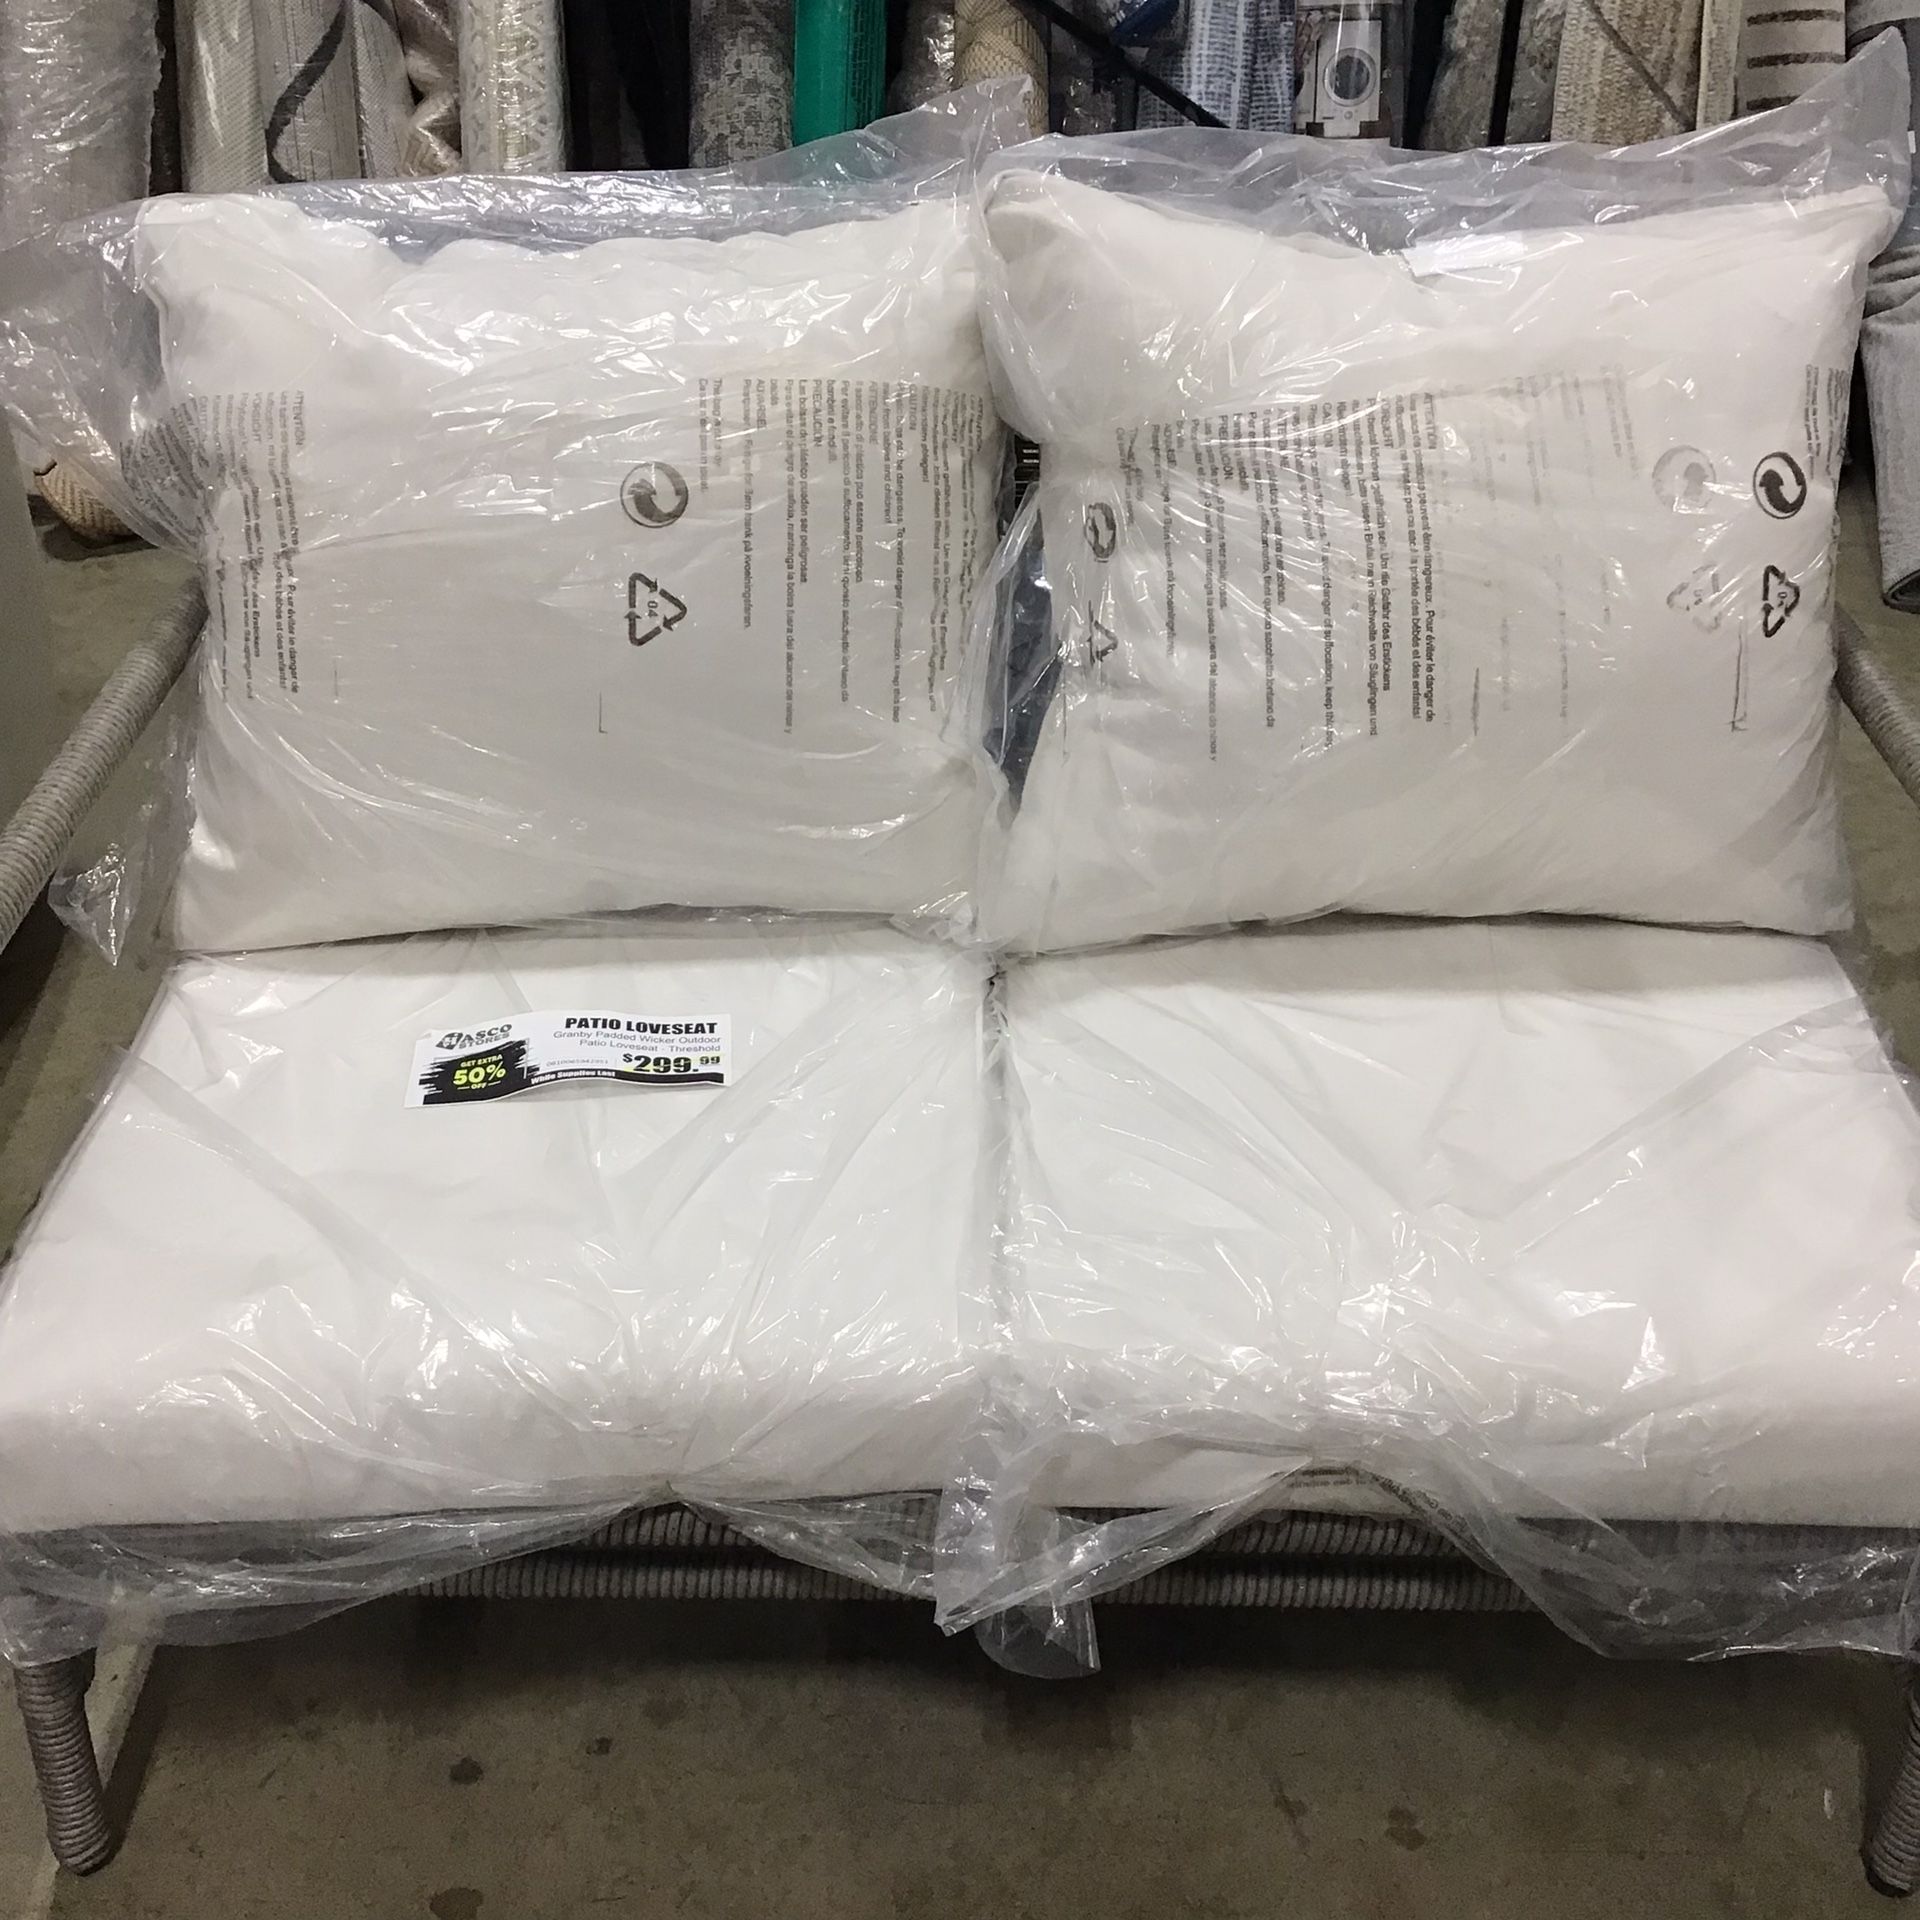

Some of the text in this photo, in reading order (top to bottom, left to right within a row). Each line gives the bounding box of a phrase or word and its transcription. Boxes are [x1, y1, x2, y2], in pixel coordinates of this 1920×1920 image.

[1425, 609, 1436, 633] Pour
[1423, 673, 1436, 708] danger
[1425, 709, 1437, 723] de
[565, 1017, 718, 1035] PATIO LOVESEAT
[553, 1031, 721, 1045] Granby Padded Wicker Outdoor
[579, 1039, 607, 1048] Patio
[609, 1041, 658, 1053] Loveseat
[669, 1045, 721, 1053] Threshold
[460, 1054, 503, 1067] GET EXTRA
[453, 1061, 506, 1085] 50%
[531, 1074, 555, 1085] While
[557, 1070, 596, 1079] Supplies
